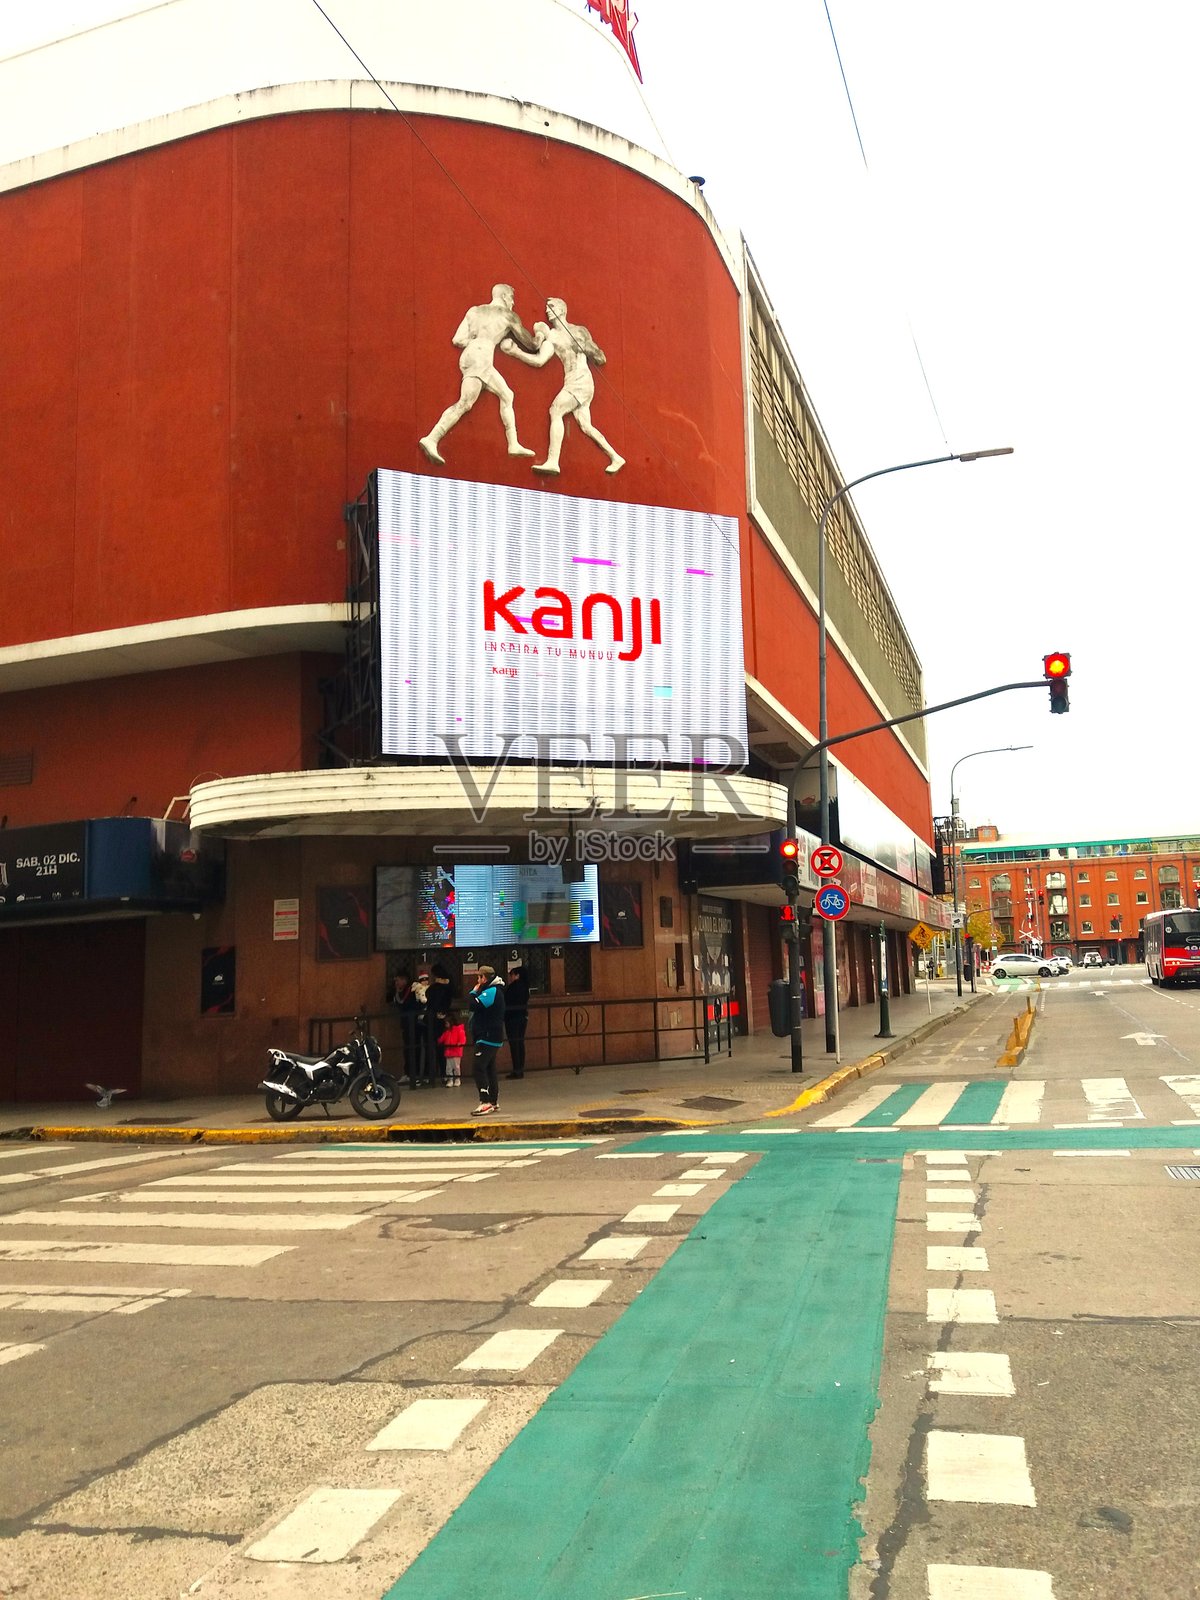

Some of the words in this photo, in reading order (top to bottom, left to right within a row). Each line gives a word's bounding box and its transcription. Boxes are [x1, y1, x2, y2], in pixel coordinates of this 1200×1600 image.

[483, 579, 662, 661] kanji
[546, 646, 562, 657] TU
[16, 856, 41, 869] SAB.
[43, 855, 56, 866] 02
[58, 852, 80, 864] DIC.
[36, 865, 57, 876] 21H
[467, 951, 475, 962] 2
[511, 950, 519, 960] 3
[553, 947, 561, 957] 4
